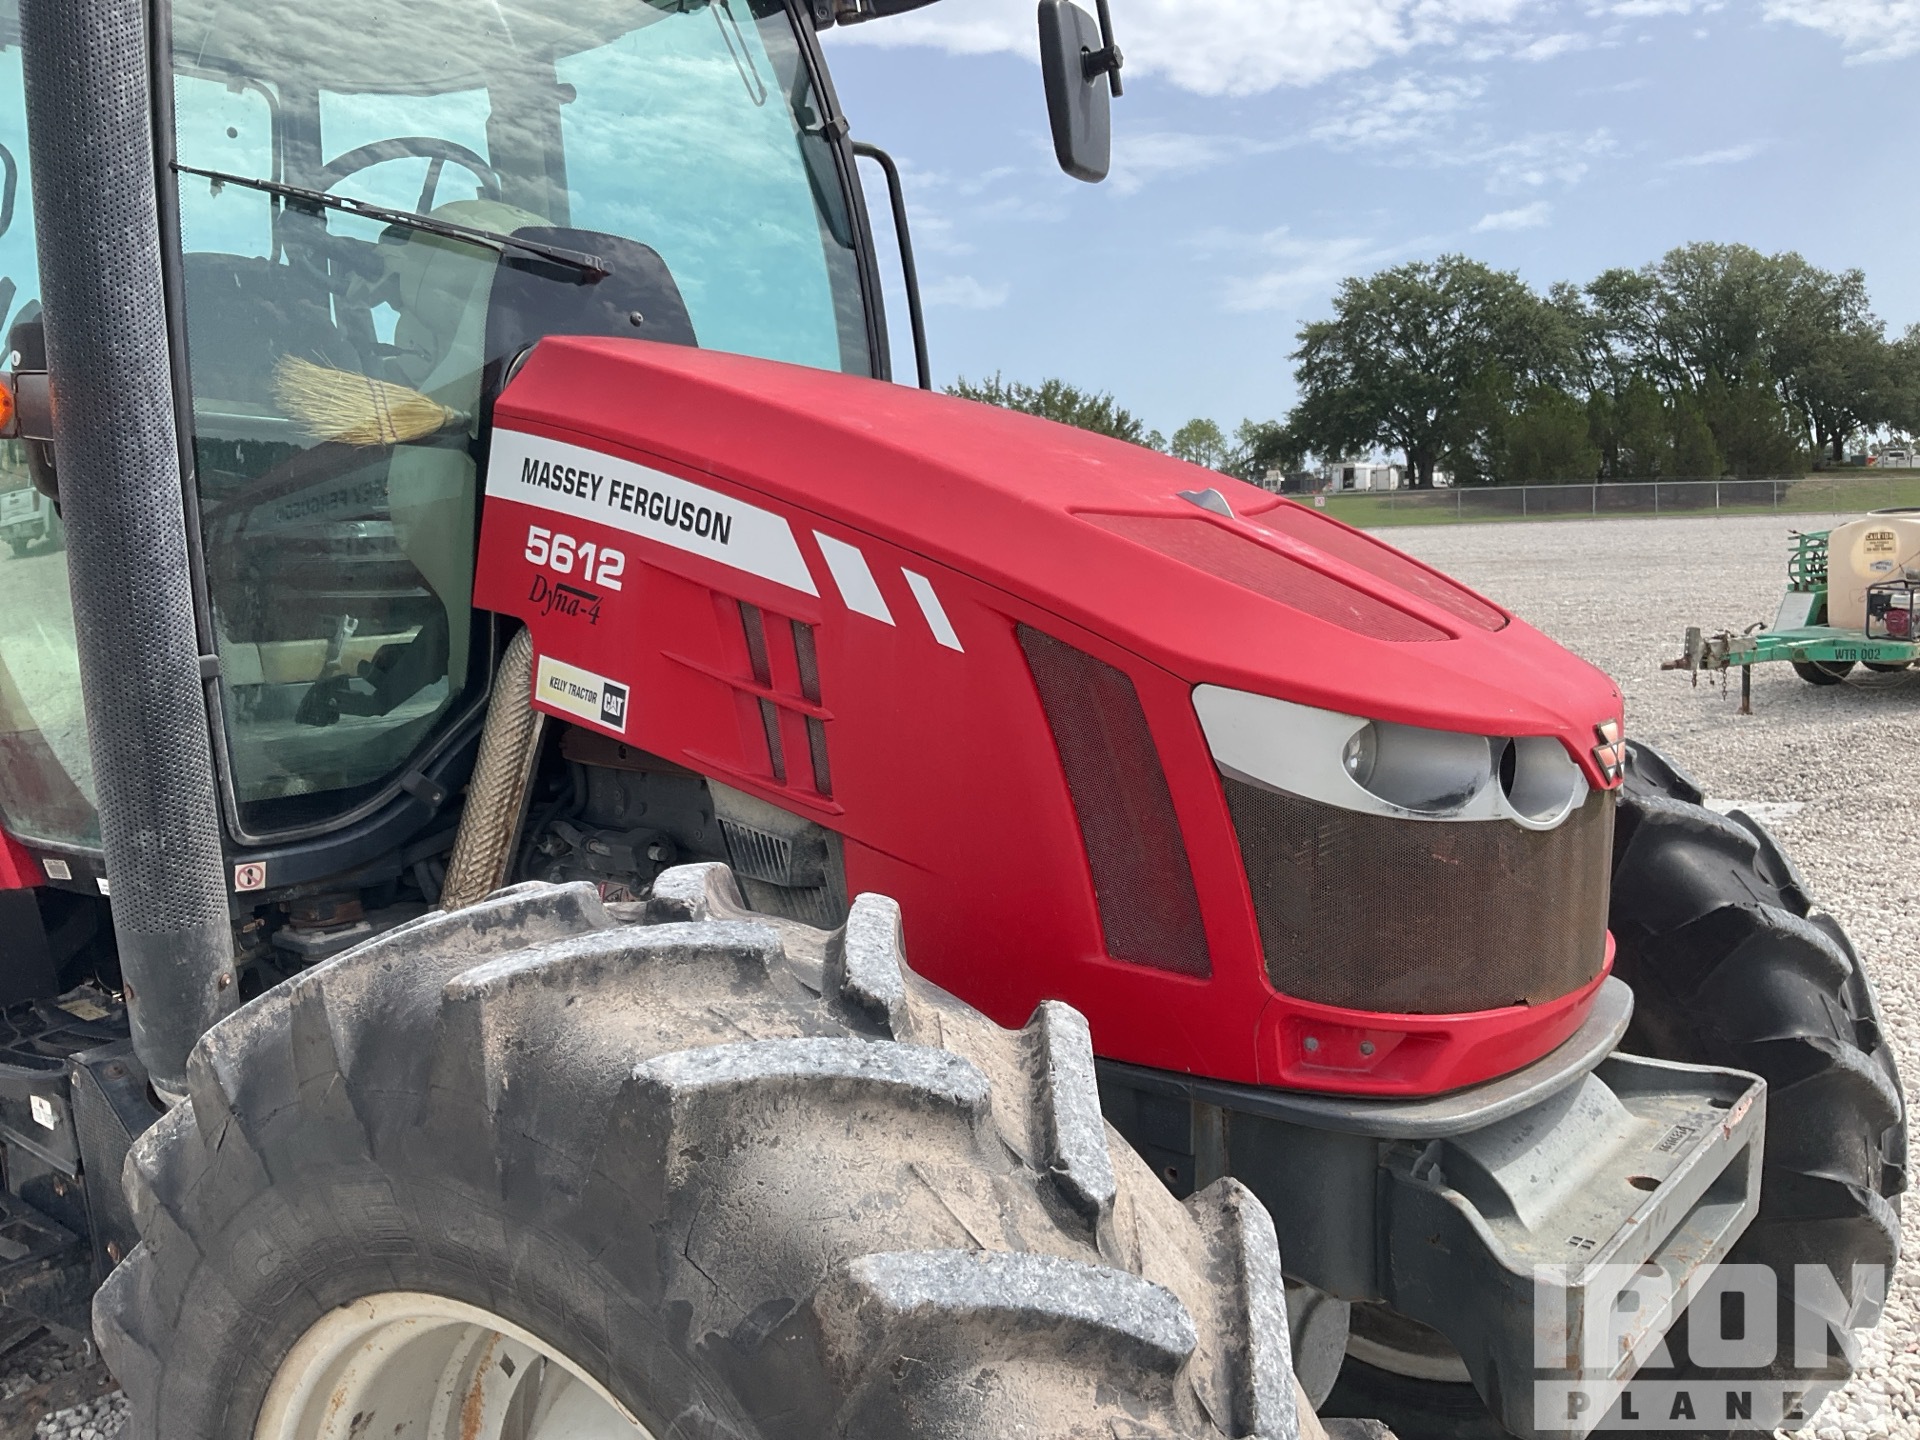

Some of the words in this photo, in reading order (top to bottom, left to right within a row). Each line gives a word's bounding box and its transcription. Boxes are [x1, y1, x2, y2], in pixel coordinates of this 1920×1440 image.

[521, 457, 603, 501] MASSEY
[608, 479, 732, 545] FERGUSON
[525, 525, 626, 591] 5612
[528, 574, 604, 625] Dyna-4
[1835, 648, 1857, 660] WTR
[1861, 648, 1881, 660] 002
[549, 675, 568, 692] KELLY
[568, 682, 598, 704] TRACTOR
[603, 692, 624, 716] CAT
